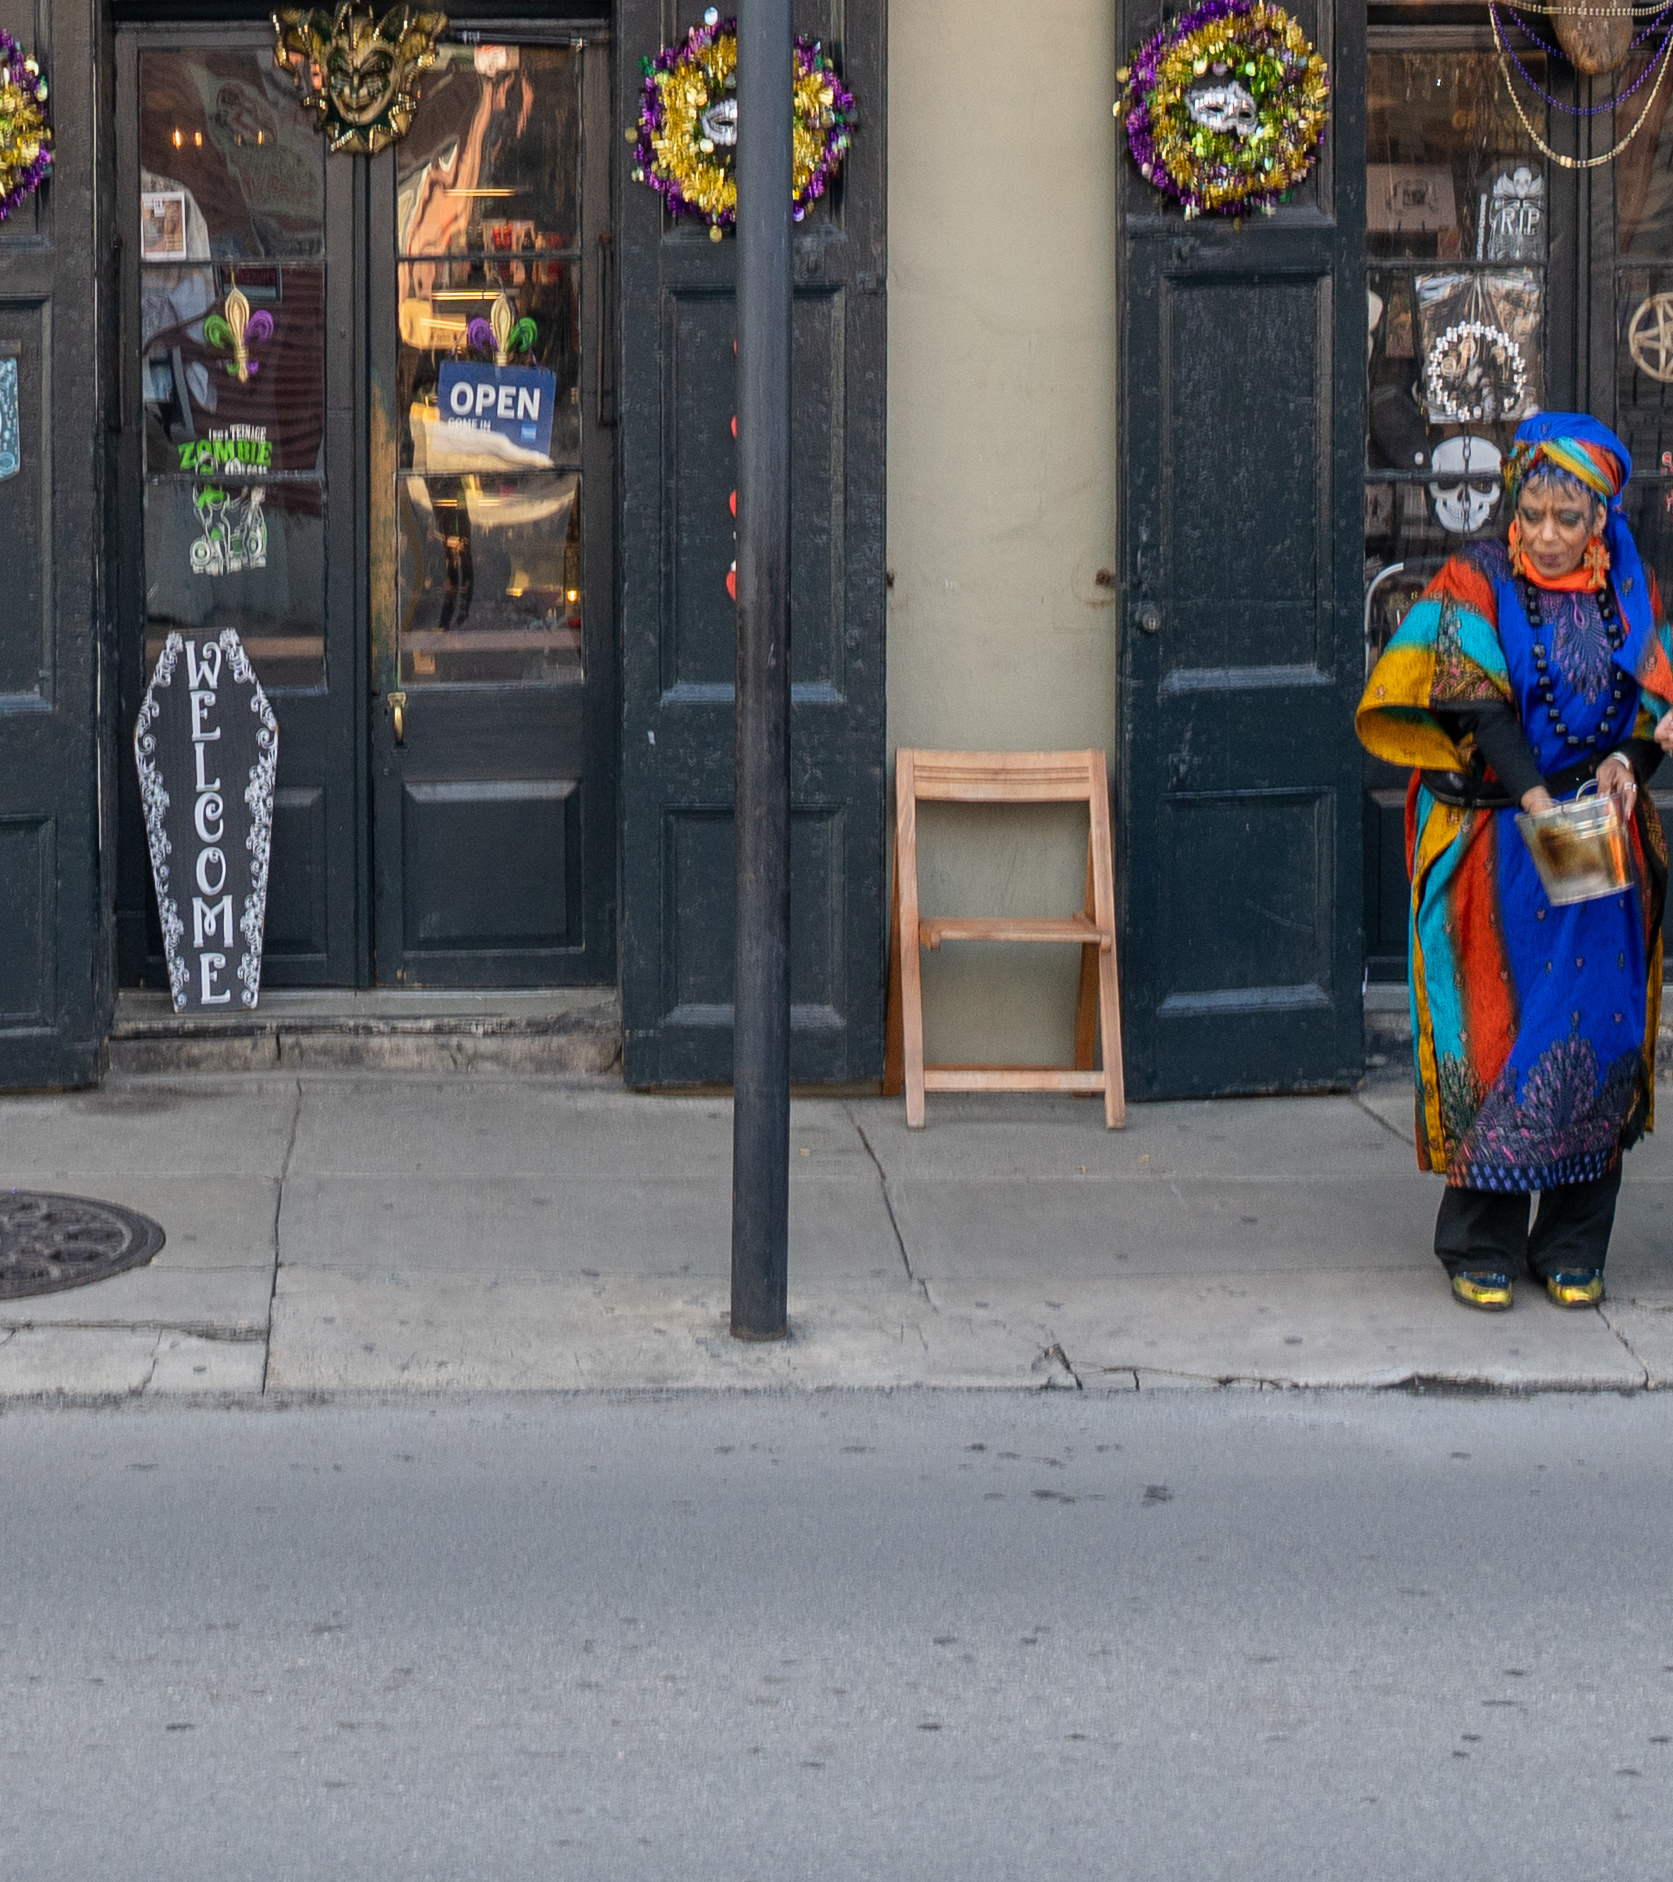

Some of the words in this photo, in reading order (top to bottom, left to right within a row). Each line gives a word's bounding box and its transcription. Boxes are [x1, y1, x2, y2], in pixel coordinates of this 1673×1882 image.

[450, 382, 540, 421] OPEN
[230, 424, 267, 443] TEENAGE
[448, 417, 477, 430] COME
[480, 419, 491, 432] IN
[177, 439, 273, 471] ZOMBIE
[185, 640, 234, 1005] WELCOME
